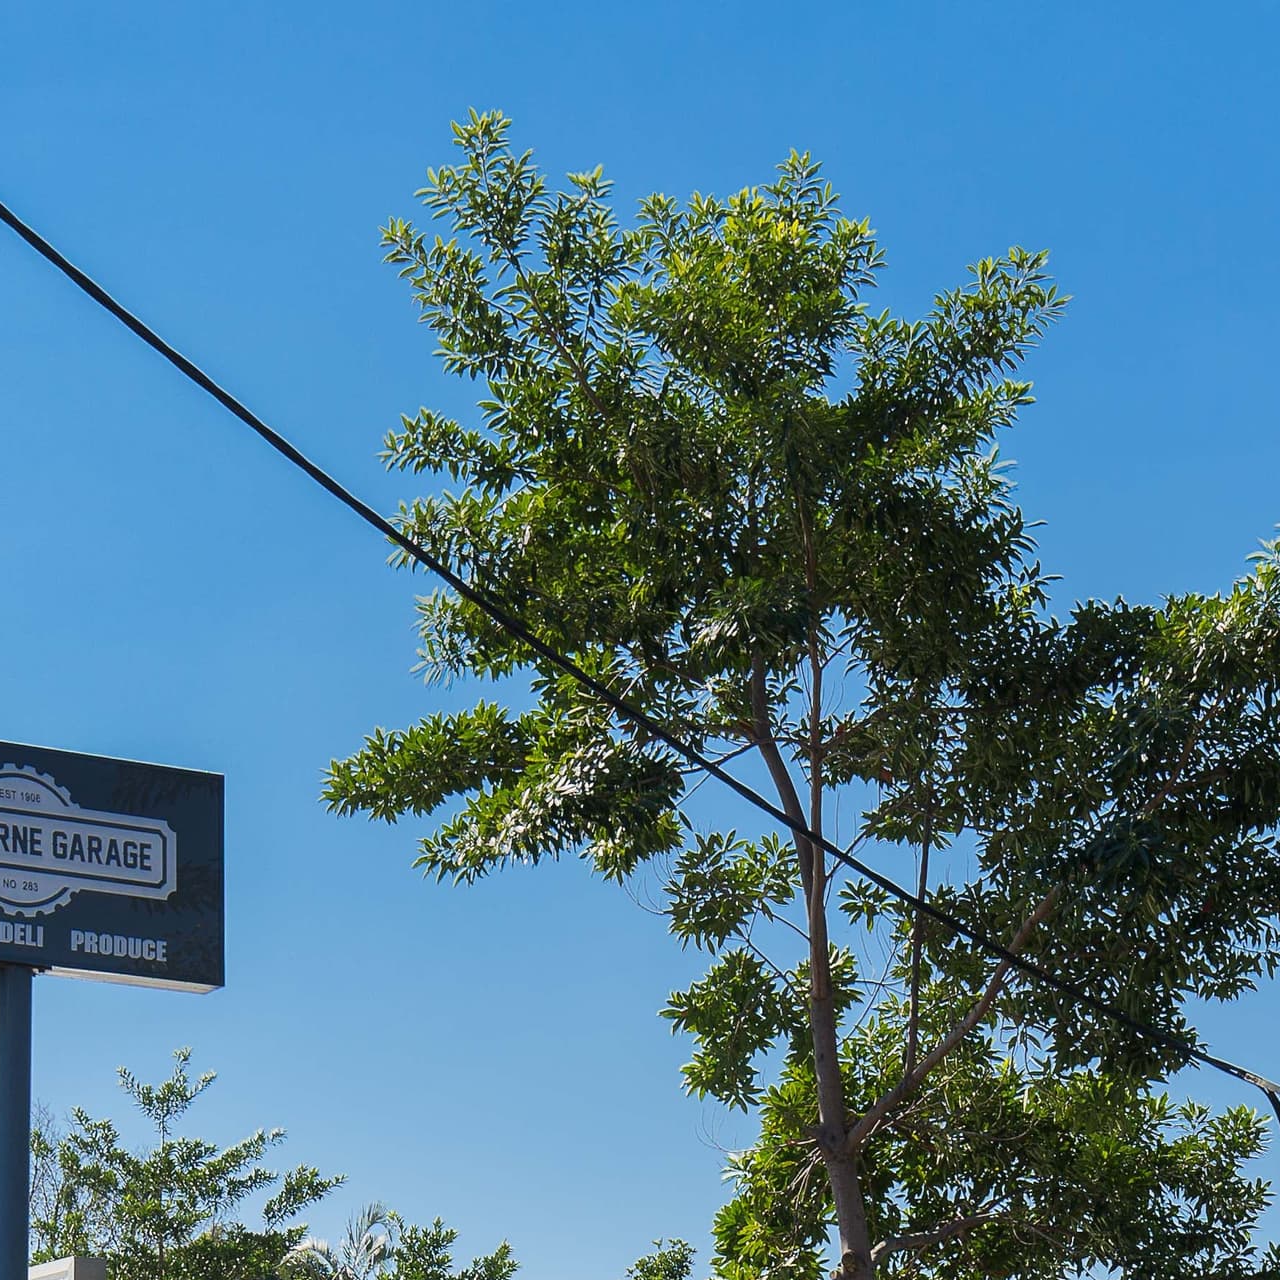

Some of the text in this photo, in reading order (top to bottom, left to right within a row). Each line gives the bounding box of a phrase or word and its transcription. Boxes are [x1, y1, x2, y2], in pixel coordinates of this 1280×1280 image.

[51, 830, 153, 872] GARAGE
[22, 880, 39, 892] 283
[70, 929, 168, 963] PRODUCE
